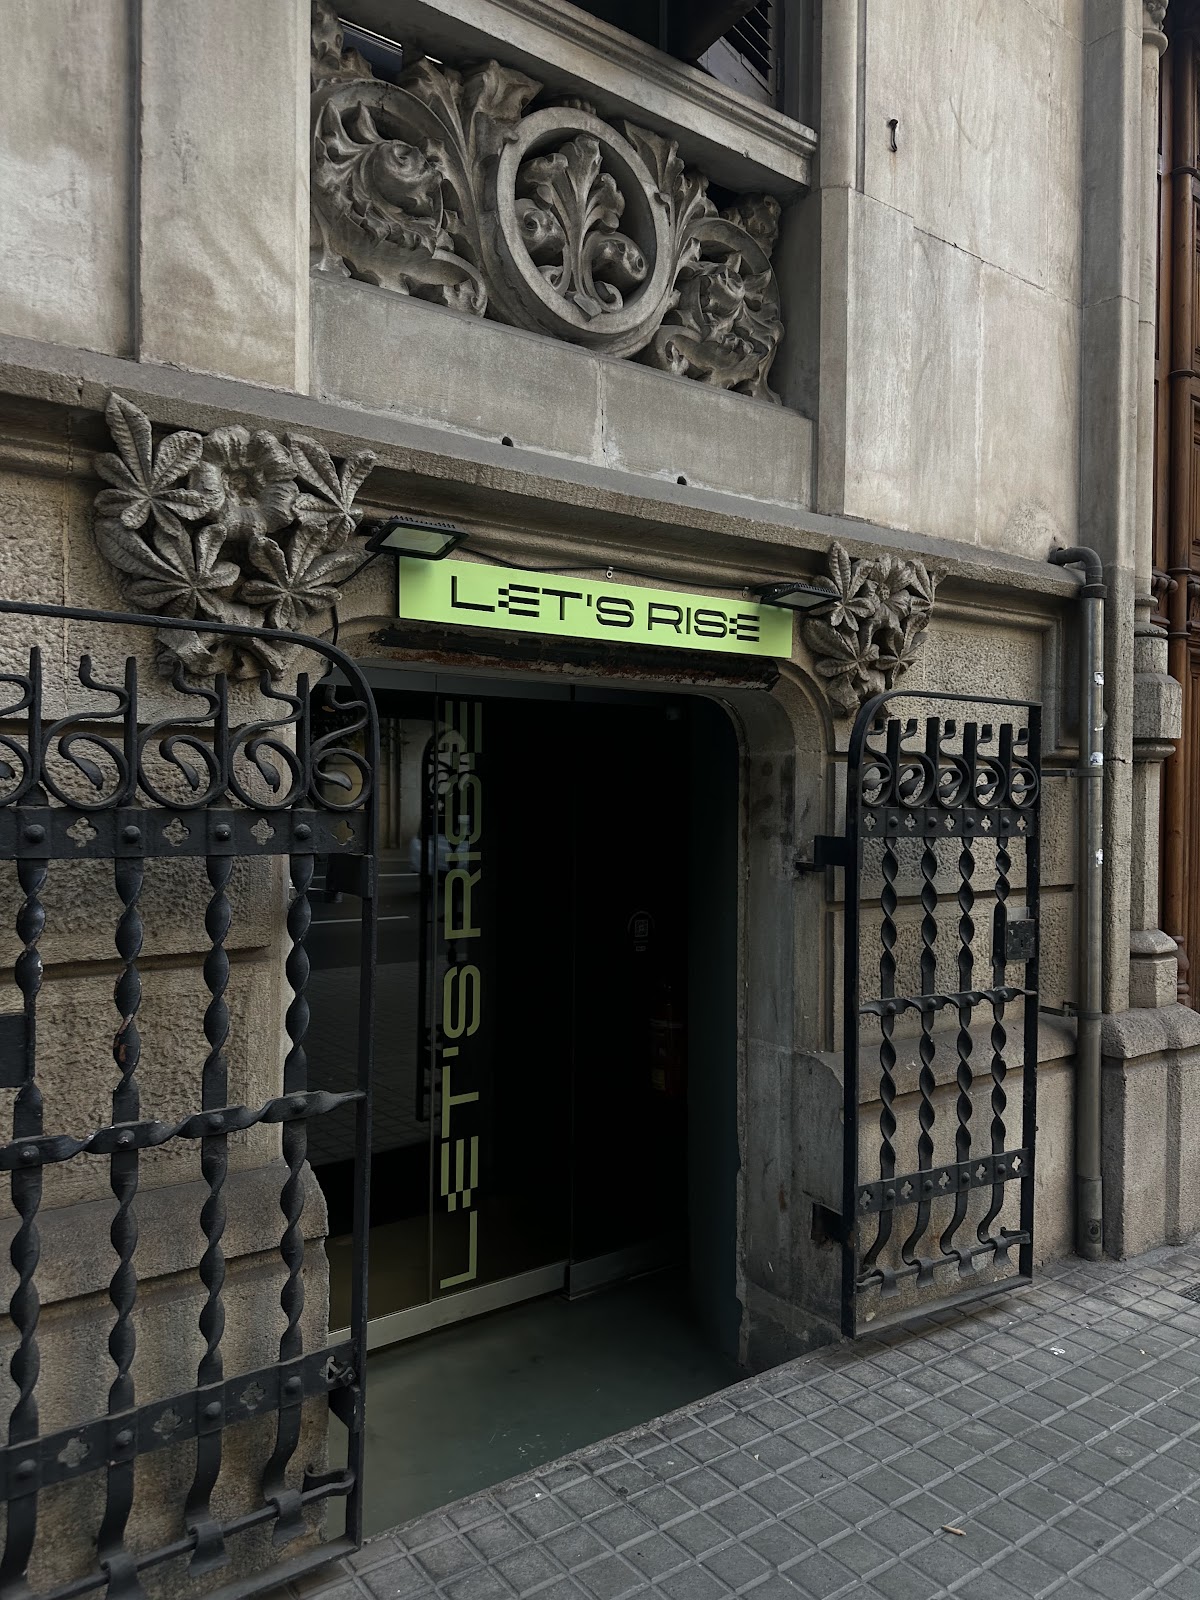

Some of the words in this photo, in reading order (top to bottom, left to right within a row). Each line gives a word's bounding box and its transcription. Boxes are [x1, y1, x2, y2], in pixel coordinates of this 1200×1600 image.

[451, 575, 635, 628] LET'S
[648, 602, 760, 642] RISE
[443, 700, 482, 938] RISE
[439, 965, 480, 1289] LET'S
